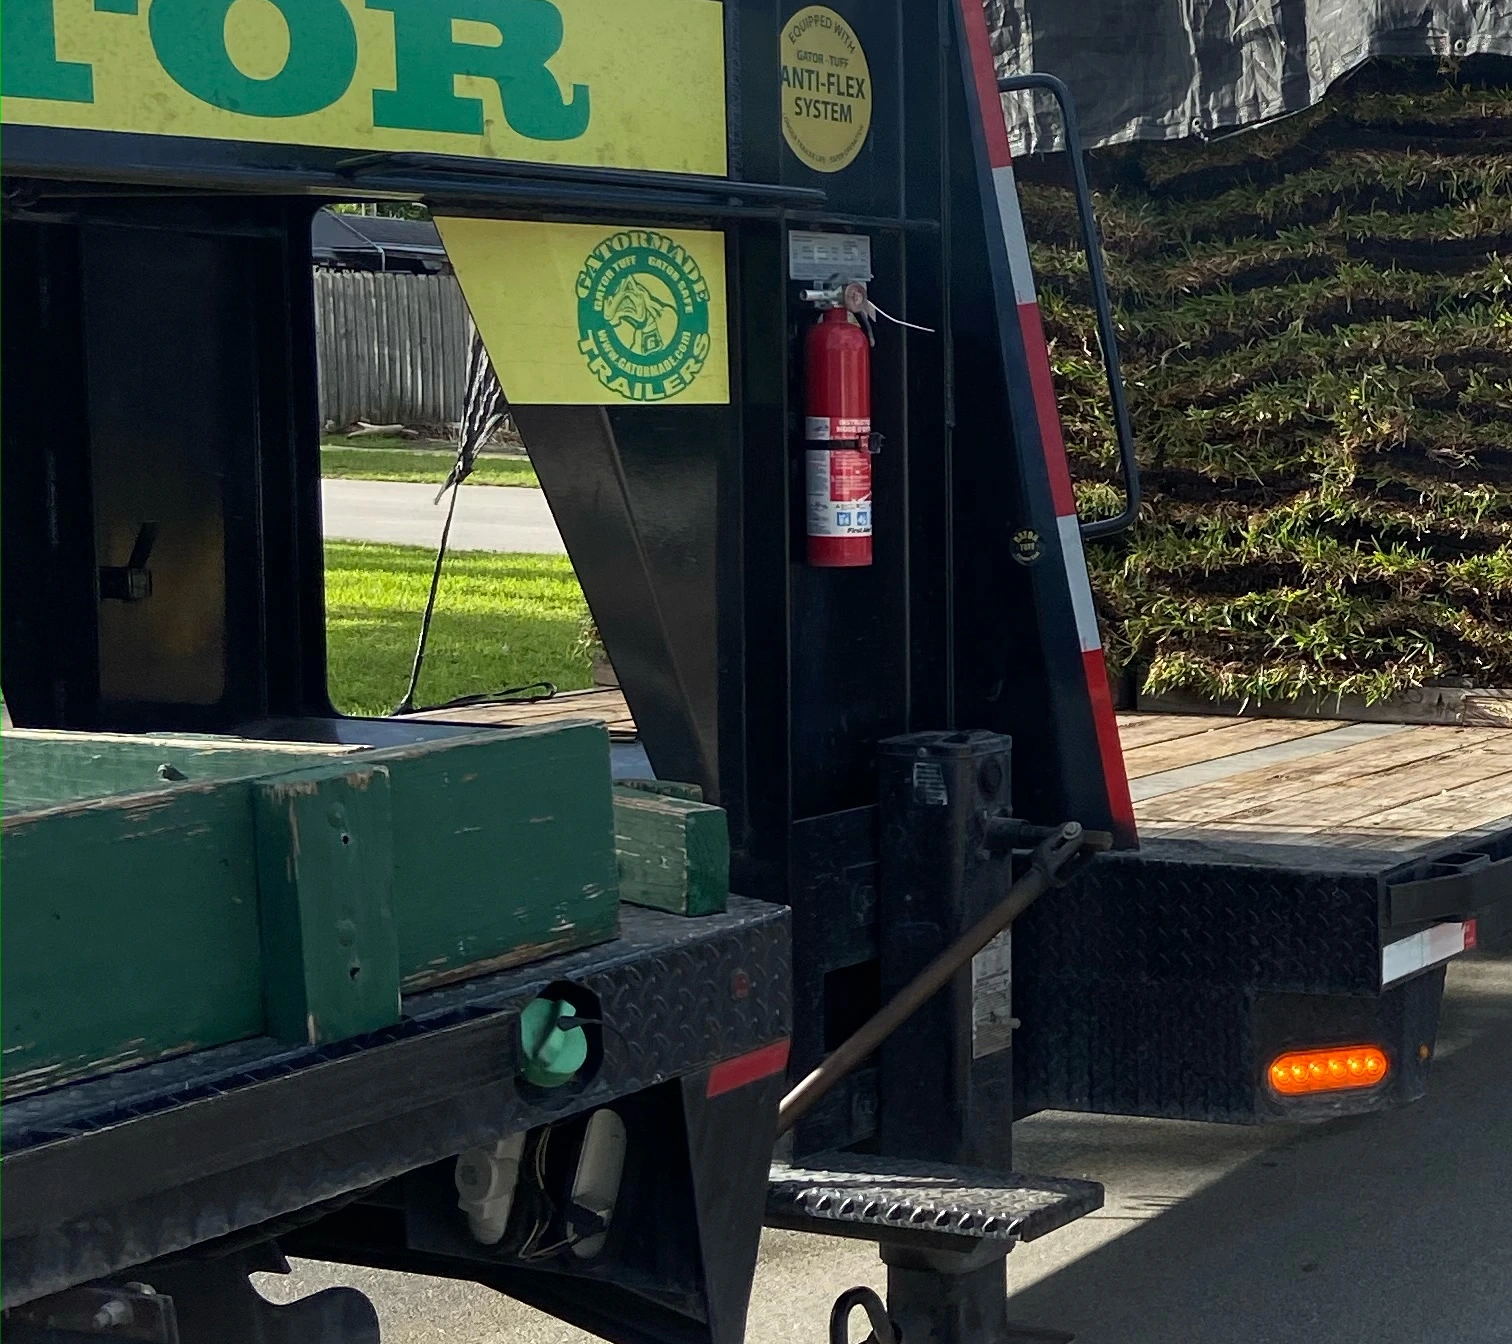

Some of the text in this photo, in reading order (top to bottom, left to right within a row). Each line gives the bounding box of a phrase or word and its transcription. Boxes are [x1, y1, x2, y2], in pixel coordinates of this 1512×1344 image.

[788, 14, 856, 54] EQUIPPED WITH
[796, 49, 824, 65] GATOR
[829, 54, 850, 69] TUFF
[780, 64, 866, 100] ANTI-FLEX
[794, 96, 853, 124] SYSTEM
[575, 229, 711, 303] GATORMADE
[594, 268, 616, 311] GATOR
[577, 329, 711, 402] TRAILERS
